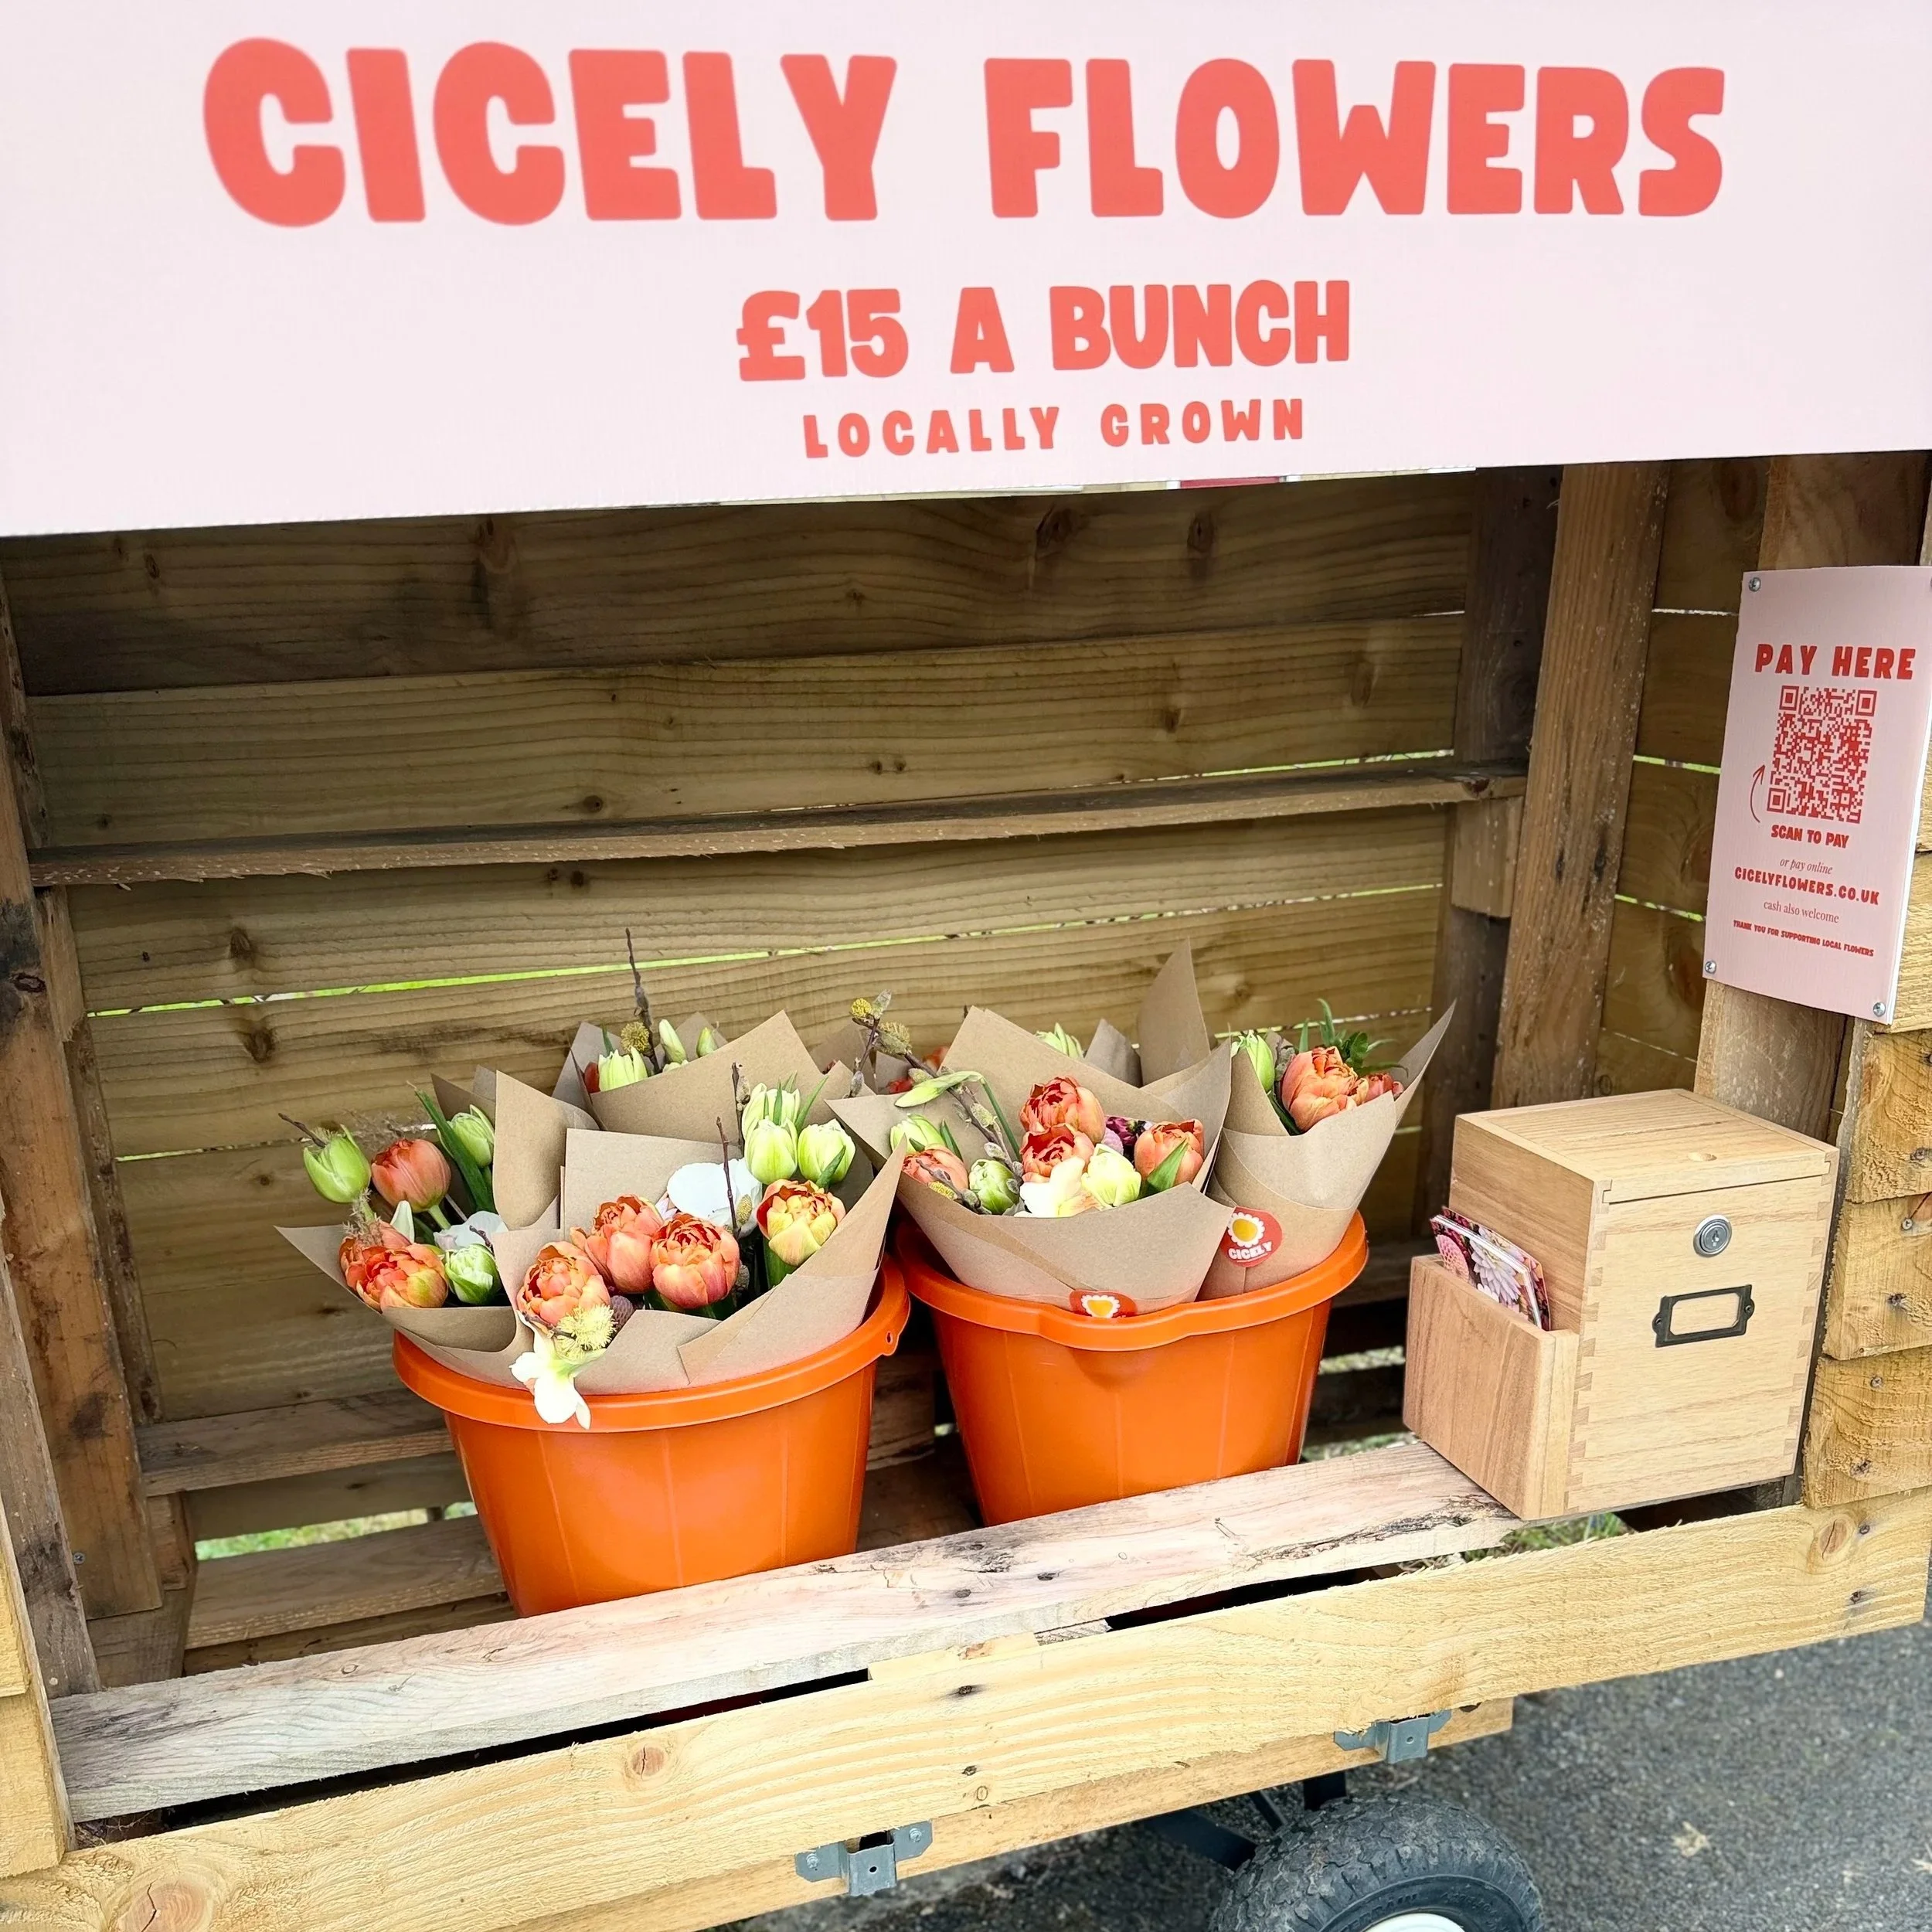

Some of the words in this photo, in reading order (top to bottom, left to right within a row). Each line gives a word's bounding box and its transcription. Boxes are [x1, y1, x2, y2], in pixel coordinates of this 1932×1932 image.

[203, 37, 896, 227] CICELY
[984, 58, 1728, 219] FLOWERS
[736, 289, 909, 381] £15
[951, 287, 1014, 373] A
[1050, 280, 1351, 370] BUNCH
[804, 407, 1060, 458] LOCALLY
[1101, 399, 1303, 447] GROWN
[1755, 644, 1818, 675] PAY
[1832, 646, 1916, 680] HERE
[1770, 825, 1803, 842] SCAN
[1807, 830, 1822, 844] TO
[1825, 832, 1849, 849] PAY
[1734, 866, 1879, 905] CICELYFLOWERS.CO.UK
[1790, 860, 1805, 871] pay
[1807, 862, 1833, 875] online
[1764, 900, 1782, 912] cash
[1784, 903, 1800, 916] also
[1802, 909, 1839, 923] welcome
[1733, 920, 1752, 931] THANK
[1754, 924, 1766, 934] YOU
[1767, 927, 1779, 937] FOR
[1781, 930, 1821, 946] SUPPORTING
[1822, 939, 1842, 951] LOCAL
[1843, 944, 1874, 957] FLOWERS
[1229, 1241, 1272, 1260] CICELY
